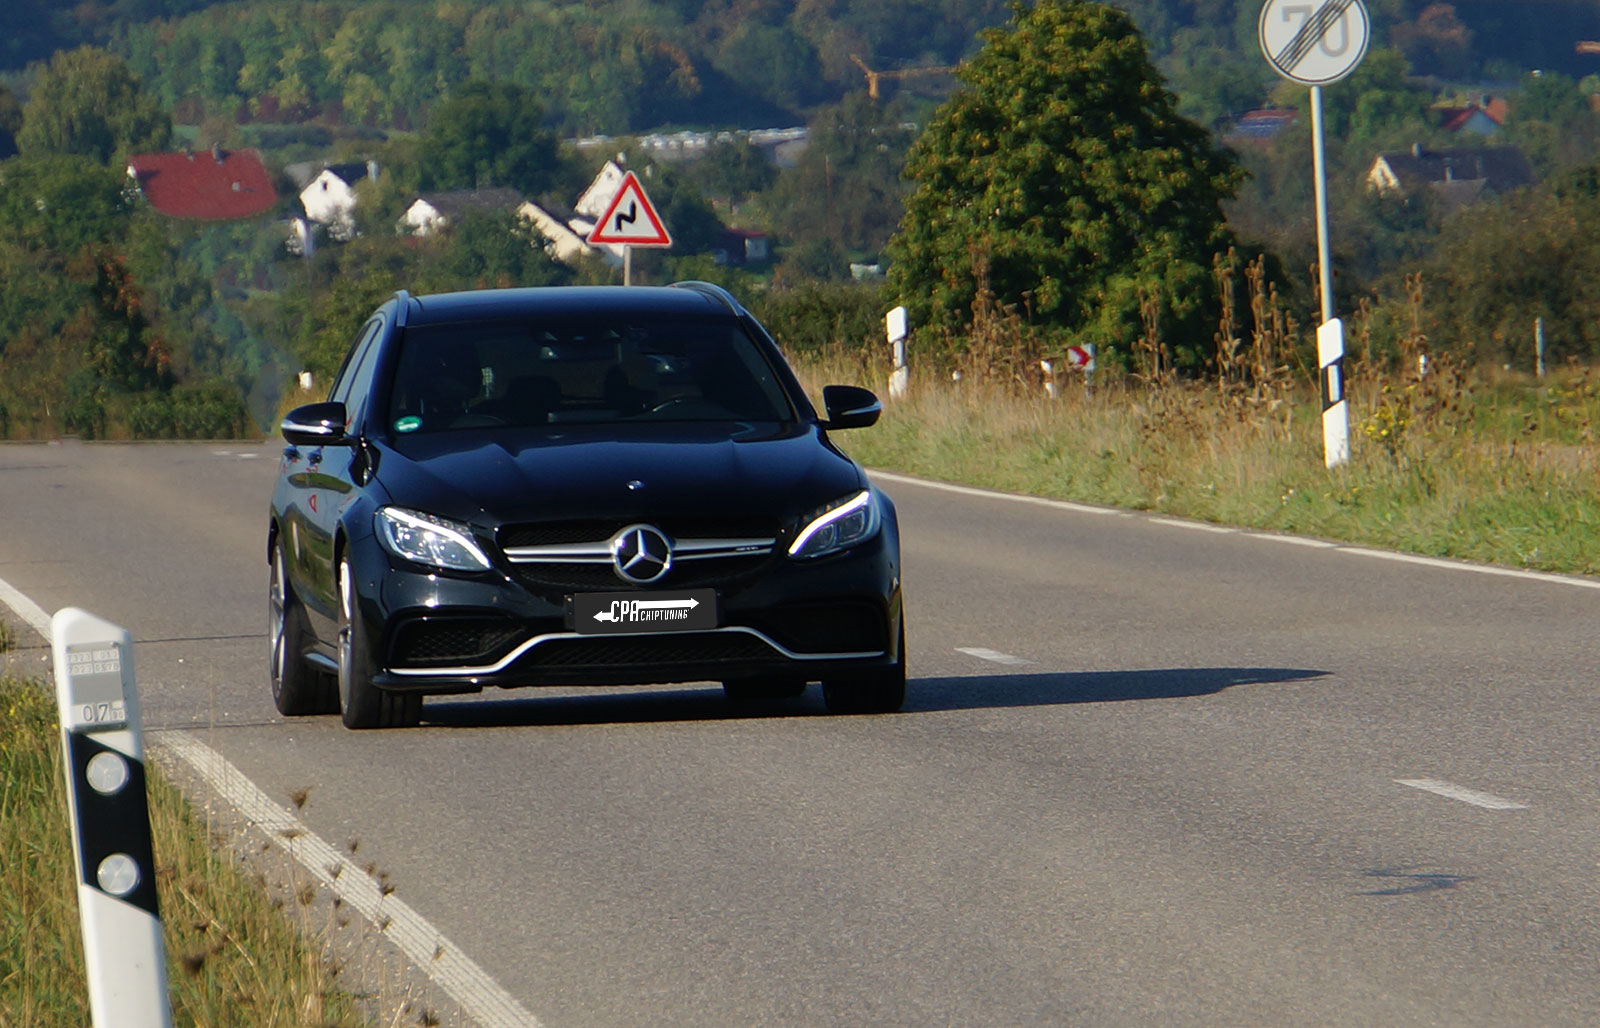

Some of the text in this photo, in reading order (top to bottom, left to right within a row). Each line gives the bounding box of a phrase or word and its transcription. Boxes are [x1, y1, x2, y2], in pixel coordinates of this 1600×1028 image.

[1281, 4, 1349, 57] 70
[610, 600, 688, 622] CPA CHIPTUNING
